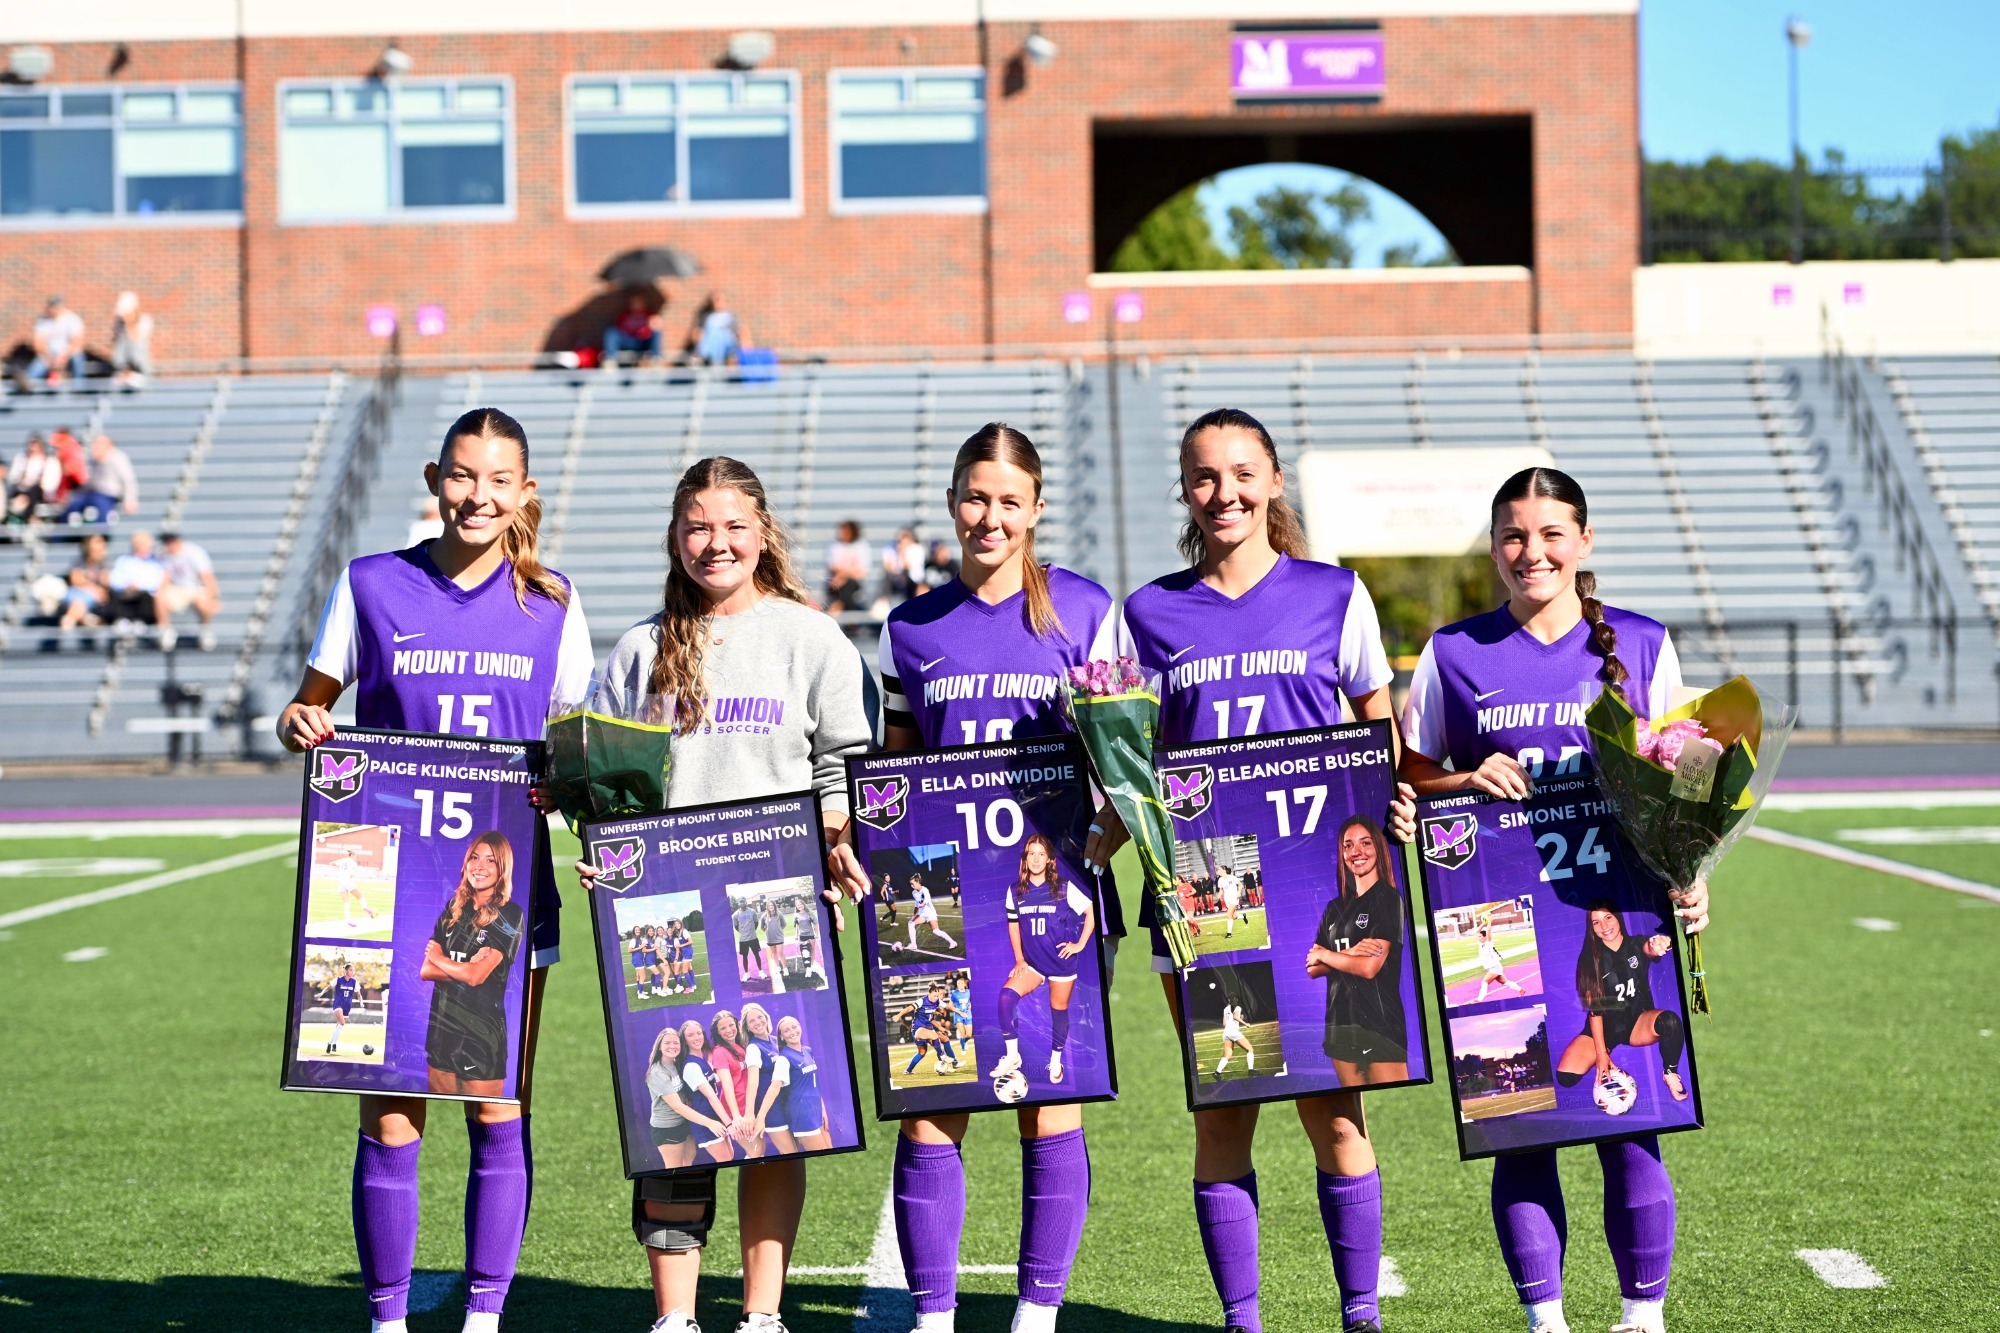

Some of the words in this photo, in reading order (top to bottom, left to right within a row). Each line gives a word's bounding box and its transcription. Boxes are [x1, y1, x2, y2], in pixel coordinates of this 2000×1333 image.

[393, 650, 470, 675] MOUNT
[475, 652, 534, 681] UNION
[1168, 654, 1236, 694] MOUNT
[1241, 650, 1308, 677] UNION
[923, 674, 989, 708] MOUNT
[993, 674, 1059, 701] UNION
[715, 697, 785, 725] UNION
[1212, 694, 1265, 739] 17
[1476, 703, 1550, 735] MOUNT
[333, 732, 387, 744] NIVERSITY
[389, 736, 404, 746] OF
[405, 737, 444, 748] MOUNT
[446, 741, 480, 751] UNION
[489, 744, 527, 755] SENIOR
[717, 725, 770, 735] SOCCER
[1168, 745, 1228, 760] UNIVERSITY
[1230, 743, 1245, 753] OF
[1247, 738, 1285, 750] MOUNT
[1288, 734, 1322, 746] UNION
[1332, 728, 1371, 740] SENIOR
[865, 756, 924, 769] UNIVERSITY
[926, 755, 941, 763] OF
[942, 750, 981, 762] MOUNT
[983, 747, 1017, 758] UNION
[1026, 743, 1066, 754] SENIOR
[1218, 757, 1320, 783] ELEANORE
[1325, 748, 1389, 770] BUSCH
[370, 760, 417, 776] PAIGE
[421, 763, 538, 785] KLINGENSMITH
[921, 775, 967, 793] ELLA
[971, 765, 1075, 788] DINWIDDIE
[1550, 780, 1585, 792] UNION
[414, 789, 473, 839] 15
[1265, 785, 1328, 837] 17
[1430, 793, 1489, 810] UNIVERSITY
[1499, 804, 1577, 829] SIMONE
[1581, 799, 1622, 816] THIE
[600, 820, 659, 835] UNIVERSITY
[661, 819, 676, 828] OF
[678, 813, 716, 826] MOUNT
[718, 809, 752, 820] UNION
[762, 803, 801, 815] SENIOR
[955, 798, 1024, 849] 10
[659, 834, 728, 854] BROOKE
[732, 824, 808, 845] BRINTON
[695, 855, 736, 866] STUDENT
[738, 850, 771, 862] COACH
[1535, 827, 1611, 882] 24
[1030, 917, 1046, 936] 10
[1615, 978, 1636, 1001] 24
